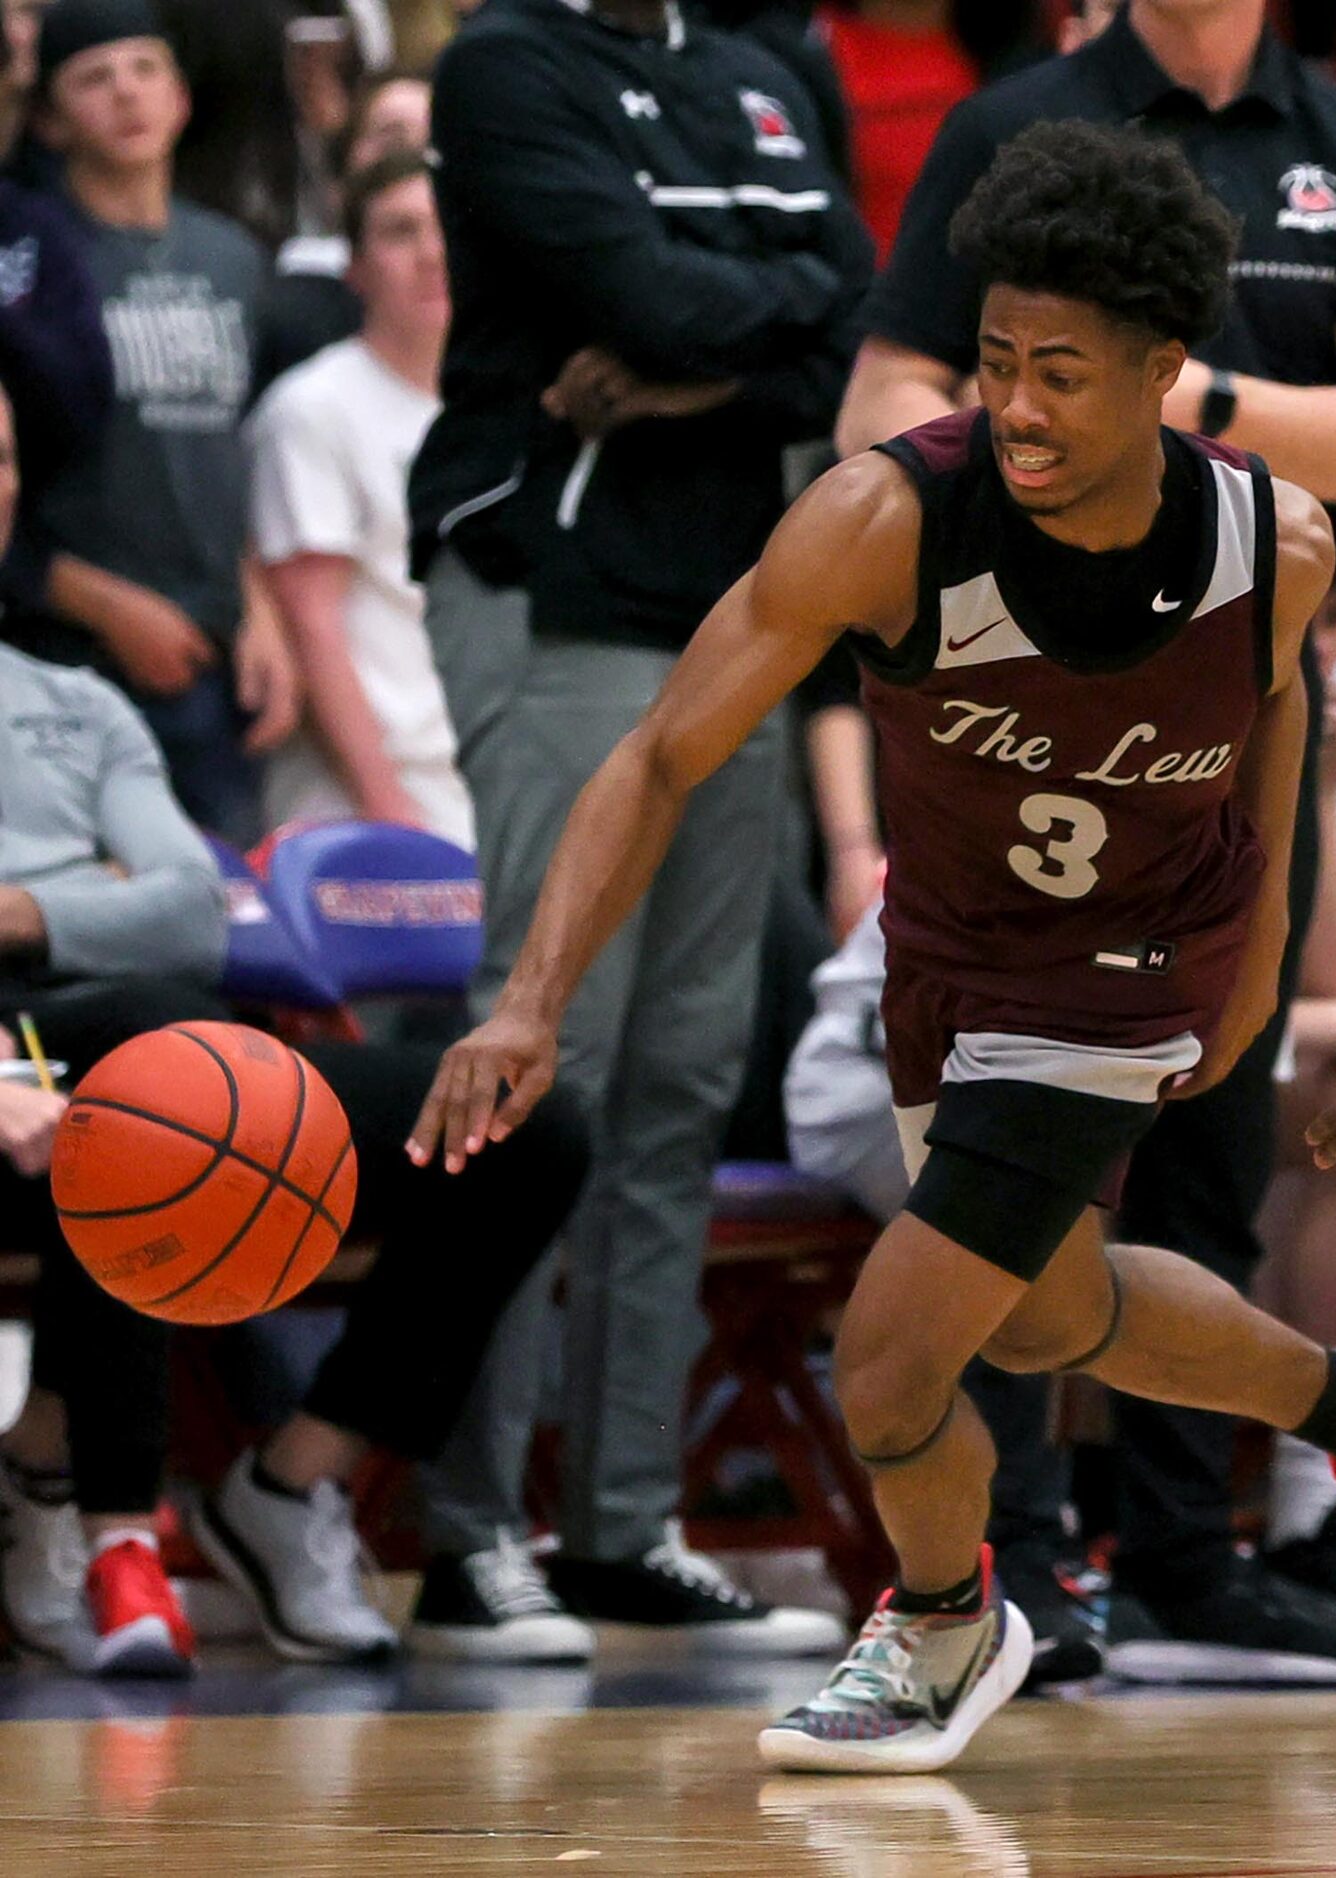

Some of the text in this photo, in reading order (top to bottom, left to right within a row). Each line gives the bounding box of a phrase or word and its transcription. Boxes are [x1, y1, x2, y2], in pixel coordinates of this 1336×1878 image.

[929, 700, 1232, 786] The Lew
[1007, 792, 1110, 899] 3
[1148, 951, 1165, 967] M
